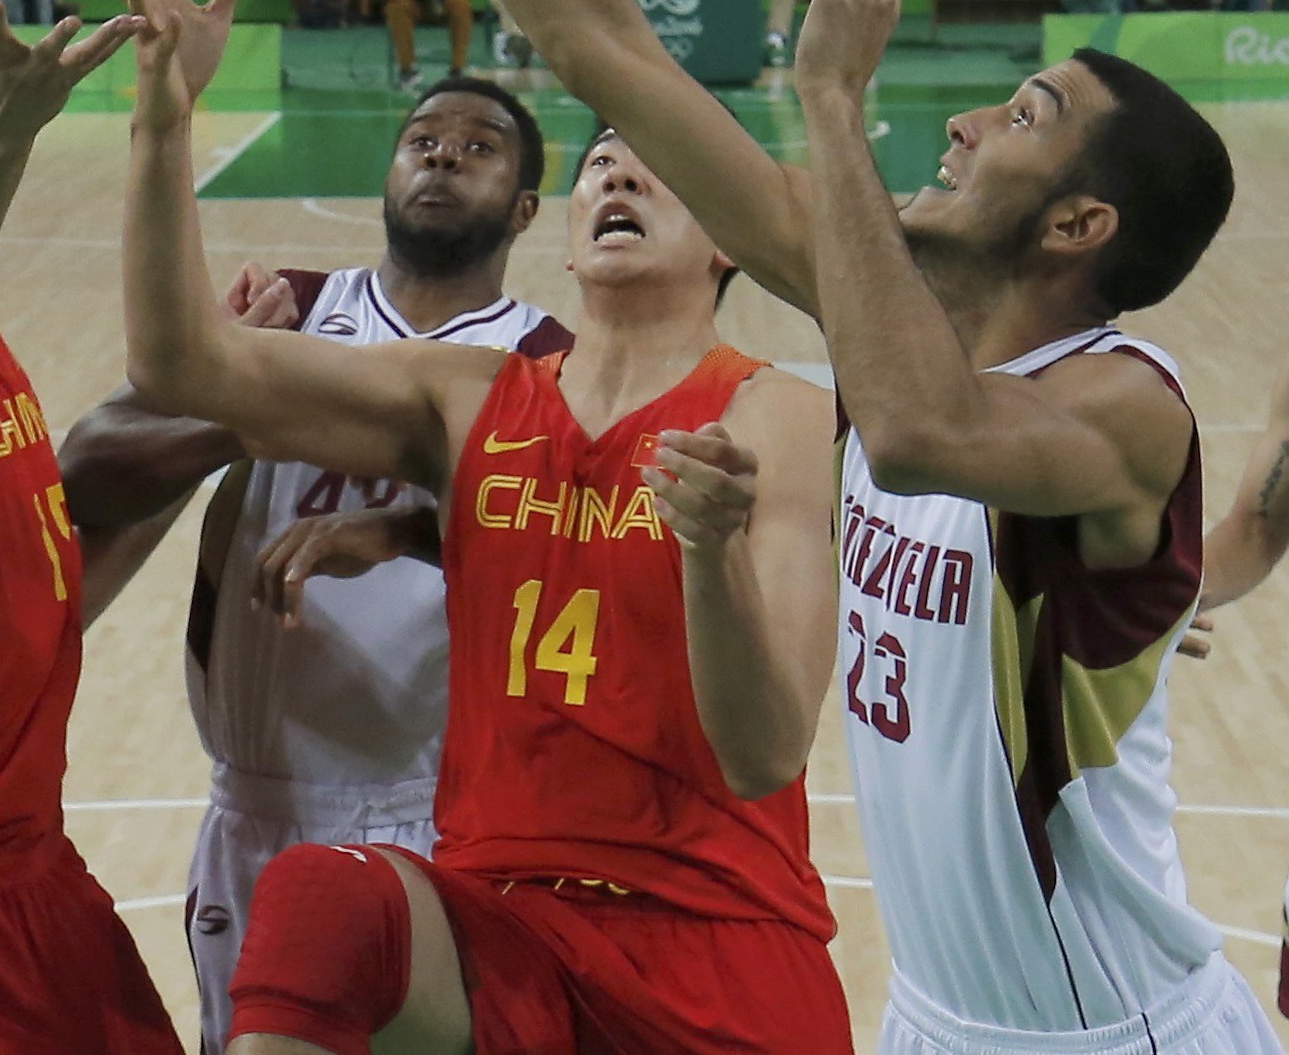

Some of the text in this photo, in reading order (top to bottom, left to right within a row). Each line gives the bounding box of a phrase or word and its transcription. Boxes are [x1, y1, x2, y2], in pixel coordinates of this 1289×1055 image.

[475, 473, 664, 543] CHINA
[506, 578, 601, 707] 14
[847, 609, 911, 744] 23
